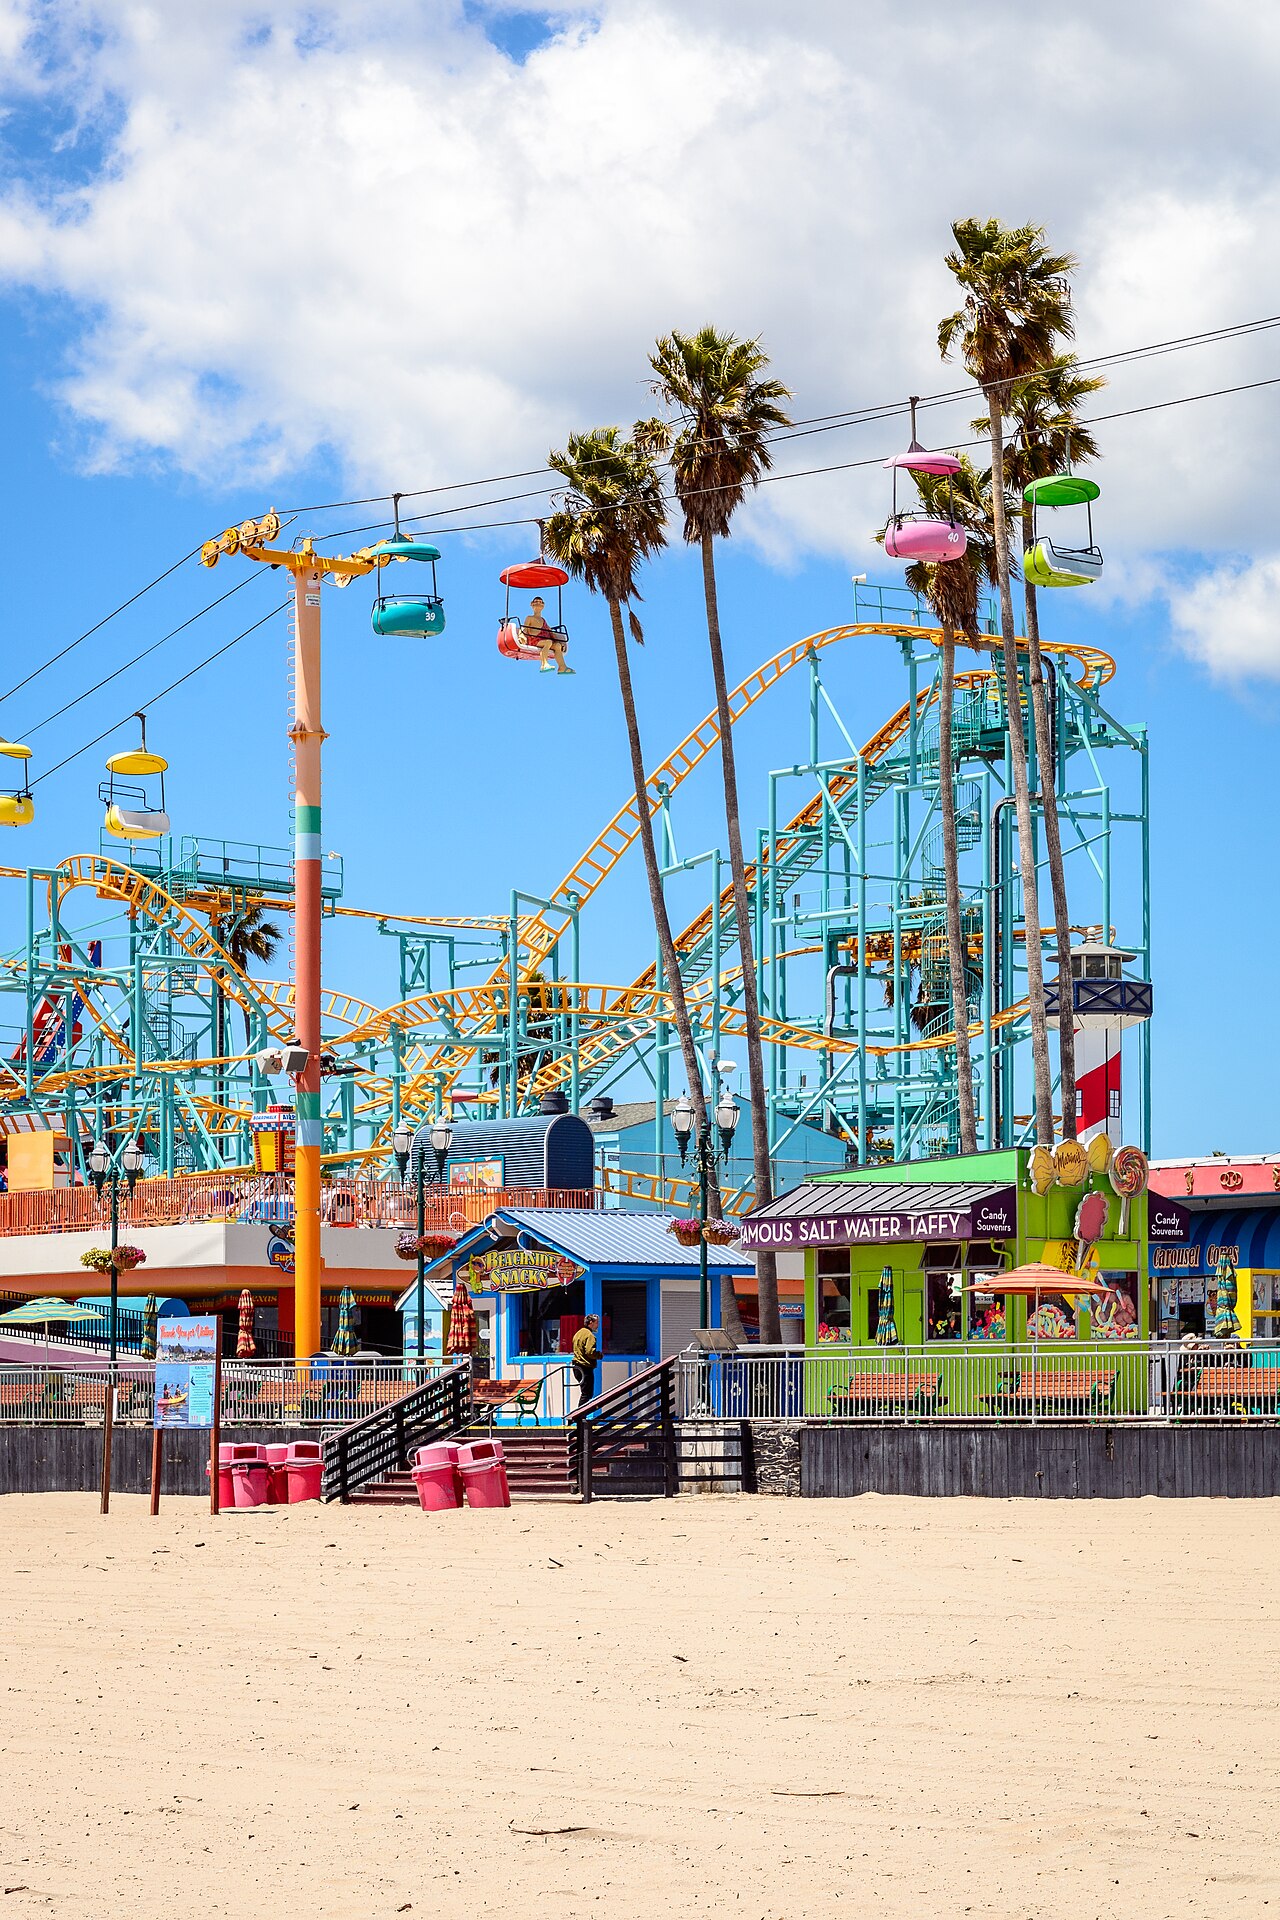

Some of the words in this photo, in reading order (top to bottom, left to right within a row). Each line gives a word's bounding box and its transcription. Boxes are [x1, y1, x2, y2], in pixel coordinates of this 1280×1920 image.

[947, 532, 959, 543] 40
[312, 572, 319, 581] 5
[425, 612, 436, 621] 39
[981, 1208, 1007, 1225] Candy
[1155, 1213, 1180, 1229] Candy
[799, 1220, 838, 1241] SALT
[844, 1216, 901, 1239] WATER
[907, 1214, 960, 1236] TAFFY
[976, 1220, 1012, 1232] Souvenirs
[1151, 1224, 1184, 1236] Souvenirs
[274, 1253, 293, 1262] Surf
[485, 1250, 557, 1273] BEACHSIDE
[1153, 1245, 1200, 1269] Carousel
[490, 1268, 548, 1292] SNACKS
[252, 1295, 278, 1303] exas
